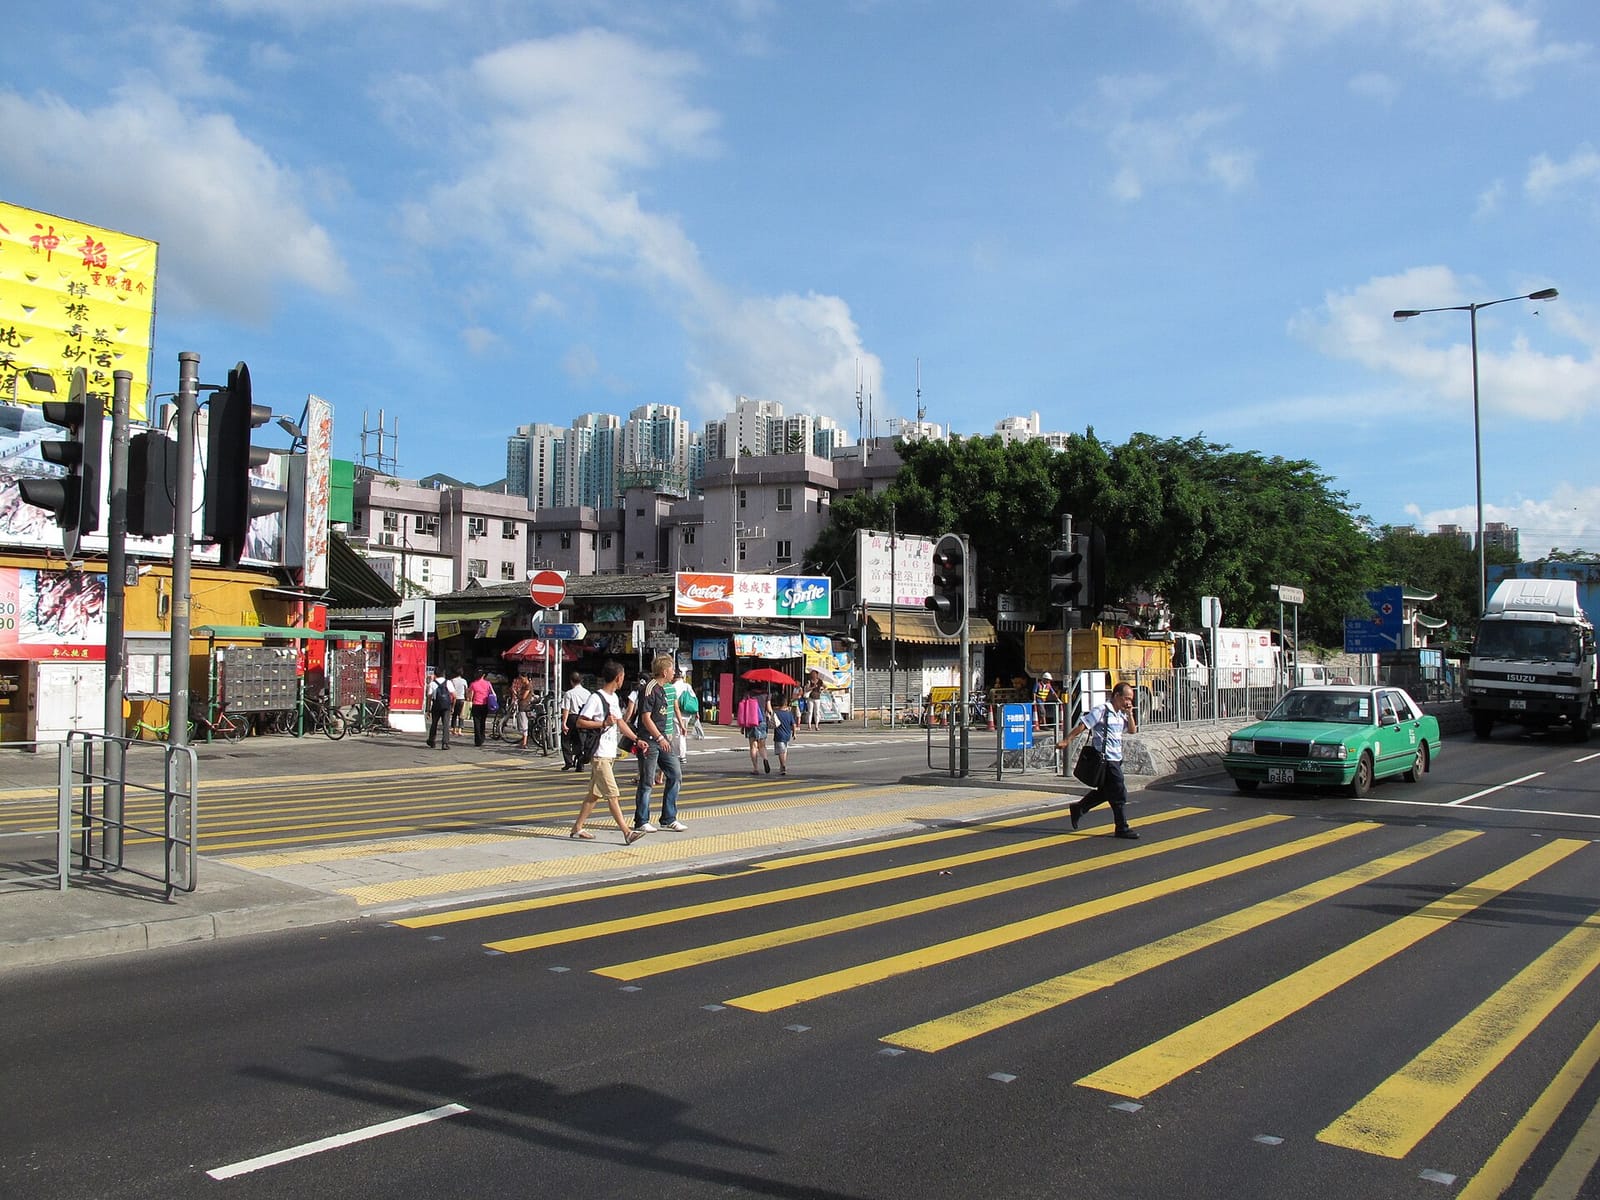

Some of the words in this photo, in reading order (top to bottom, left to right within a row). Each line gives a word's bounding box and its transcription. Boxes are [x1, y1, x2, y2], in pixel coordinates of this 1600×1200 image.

[90, 271, 148, 296] 重點推介
[61, 281, 91, 384] 檸檬奇妙
[743, 598, 765, 610] 士多
[781, 584, 826, 609] Sprite
[1507, 674, 1536, 683] ISUZU
